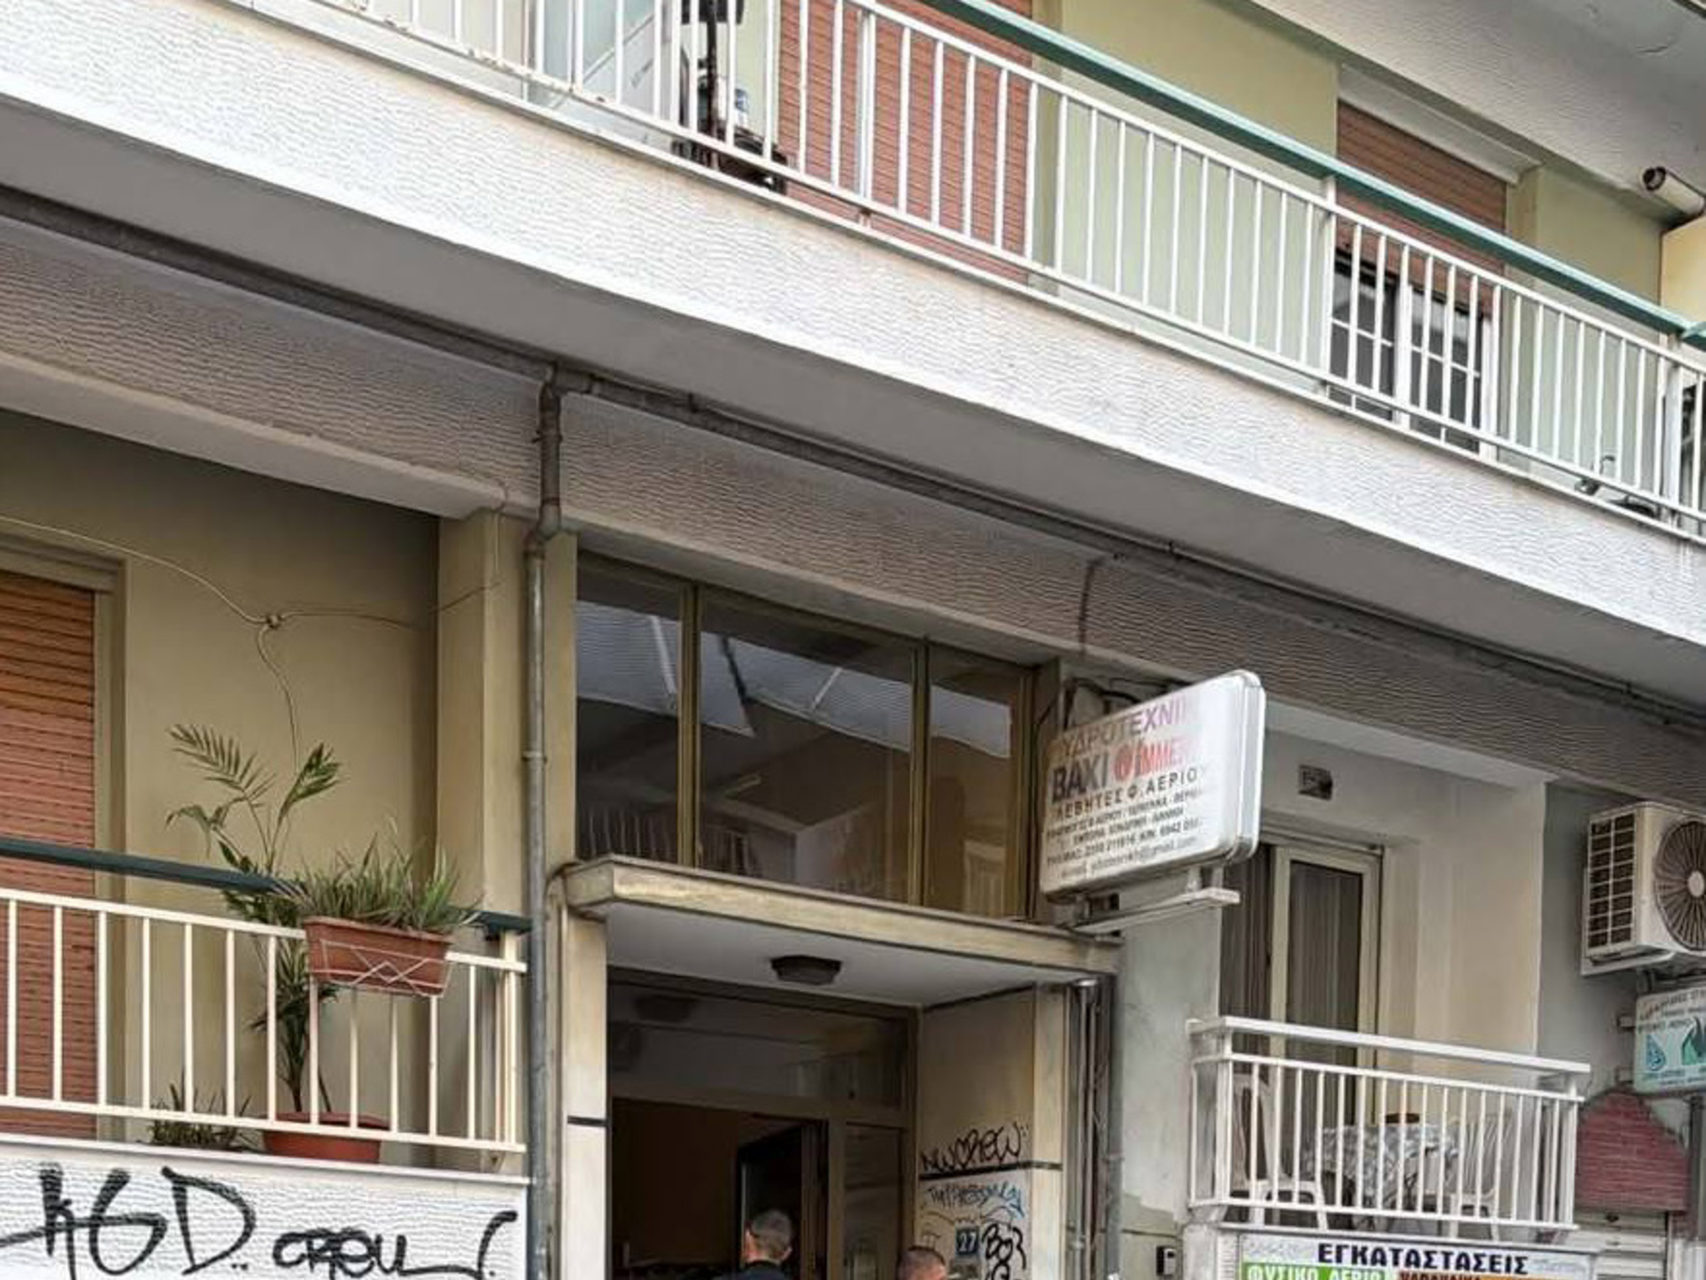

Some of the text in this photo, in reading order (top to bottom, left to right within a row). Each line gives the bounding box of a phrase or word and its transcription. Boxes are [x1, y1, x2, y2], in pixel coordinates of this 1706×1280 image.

[1052, 750, 1109, 806] BAXI
[959, 1231, 977, 1253] 27
[1318, 1243, 1529, 1275] ΕΓΚΑΤΑΣΤΑΣΕΙΣ
